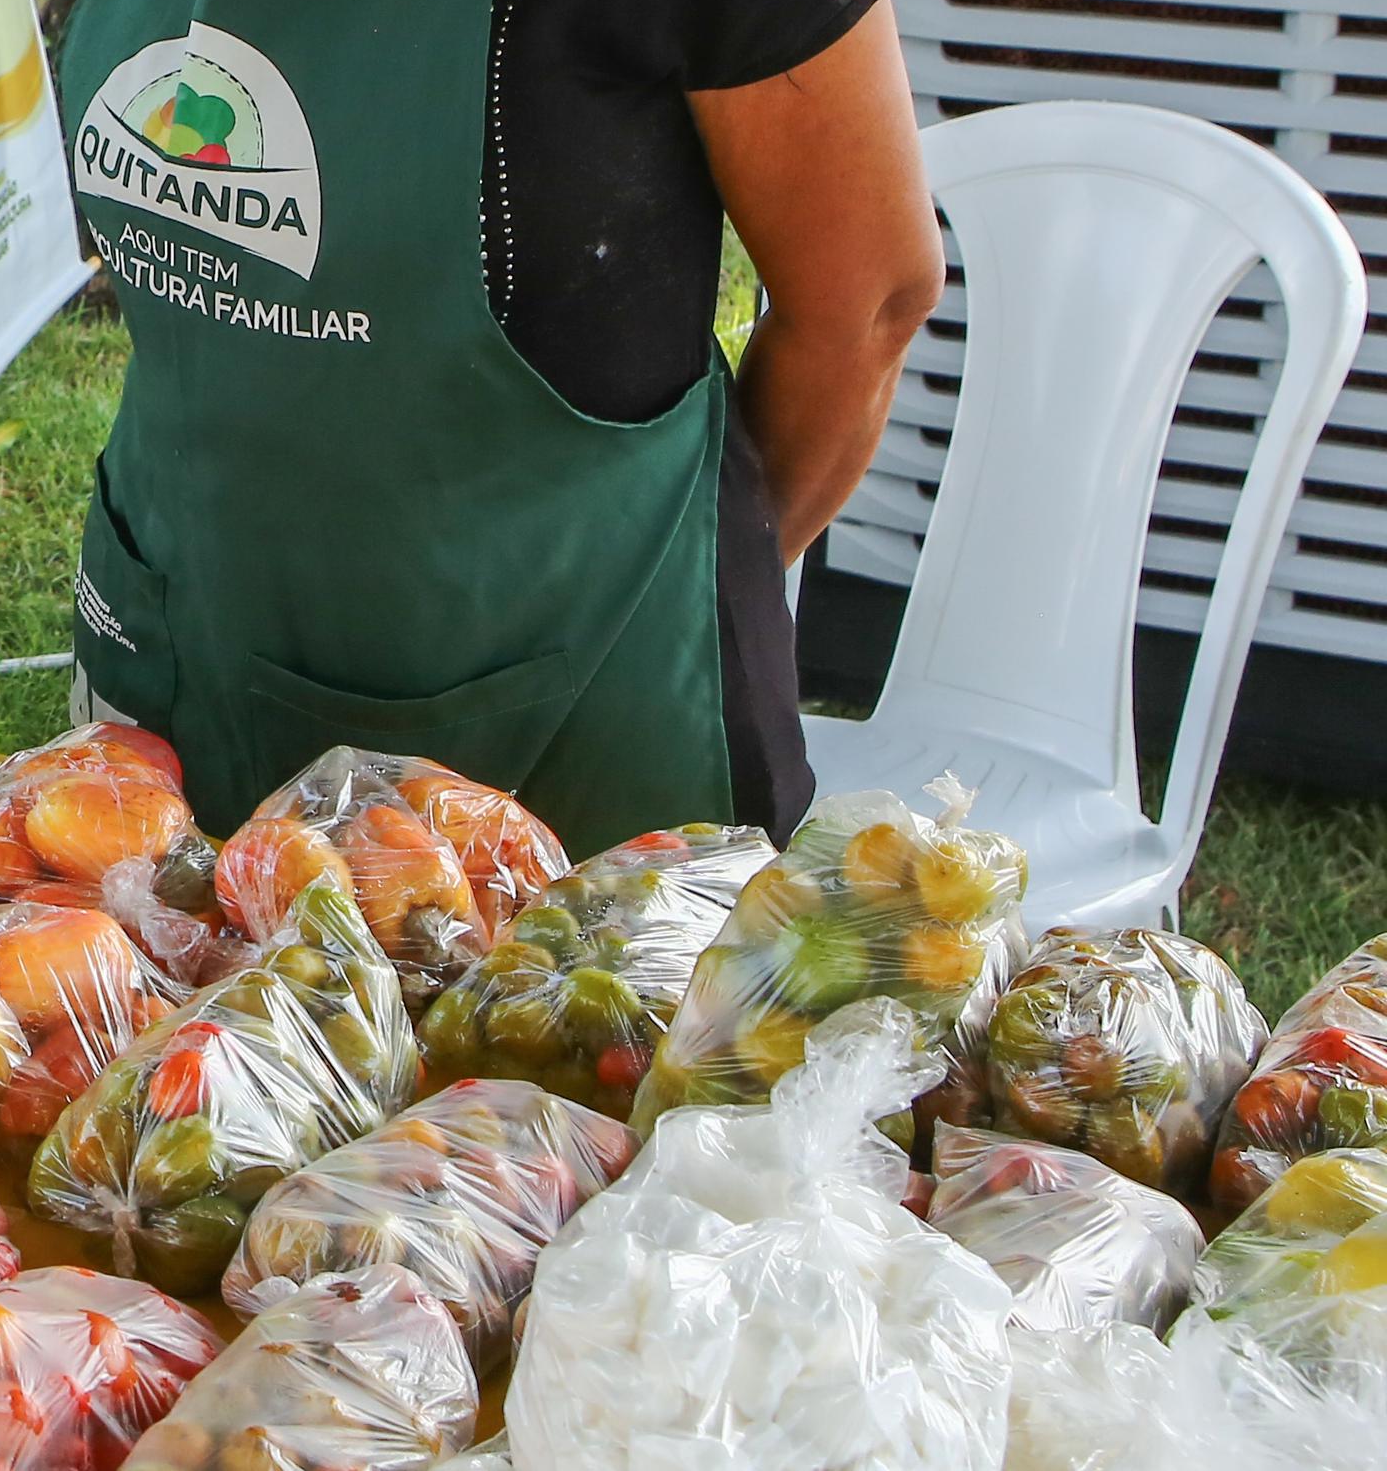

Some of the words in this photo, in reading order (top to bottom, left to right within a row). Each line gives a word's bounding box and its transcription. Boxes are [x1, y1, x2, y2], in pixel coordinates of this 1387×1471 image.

[80, 124, 308, 237] QUITANDA
[119, 222, 175, 267] AQUI
[180, 245, 239, 287] TEM
[214, 290, 372, 344] FAMILIAR
